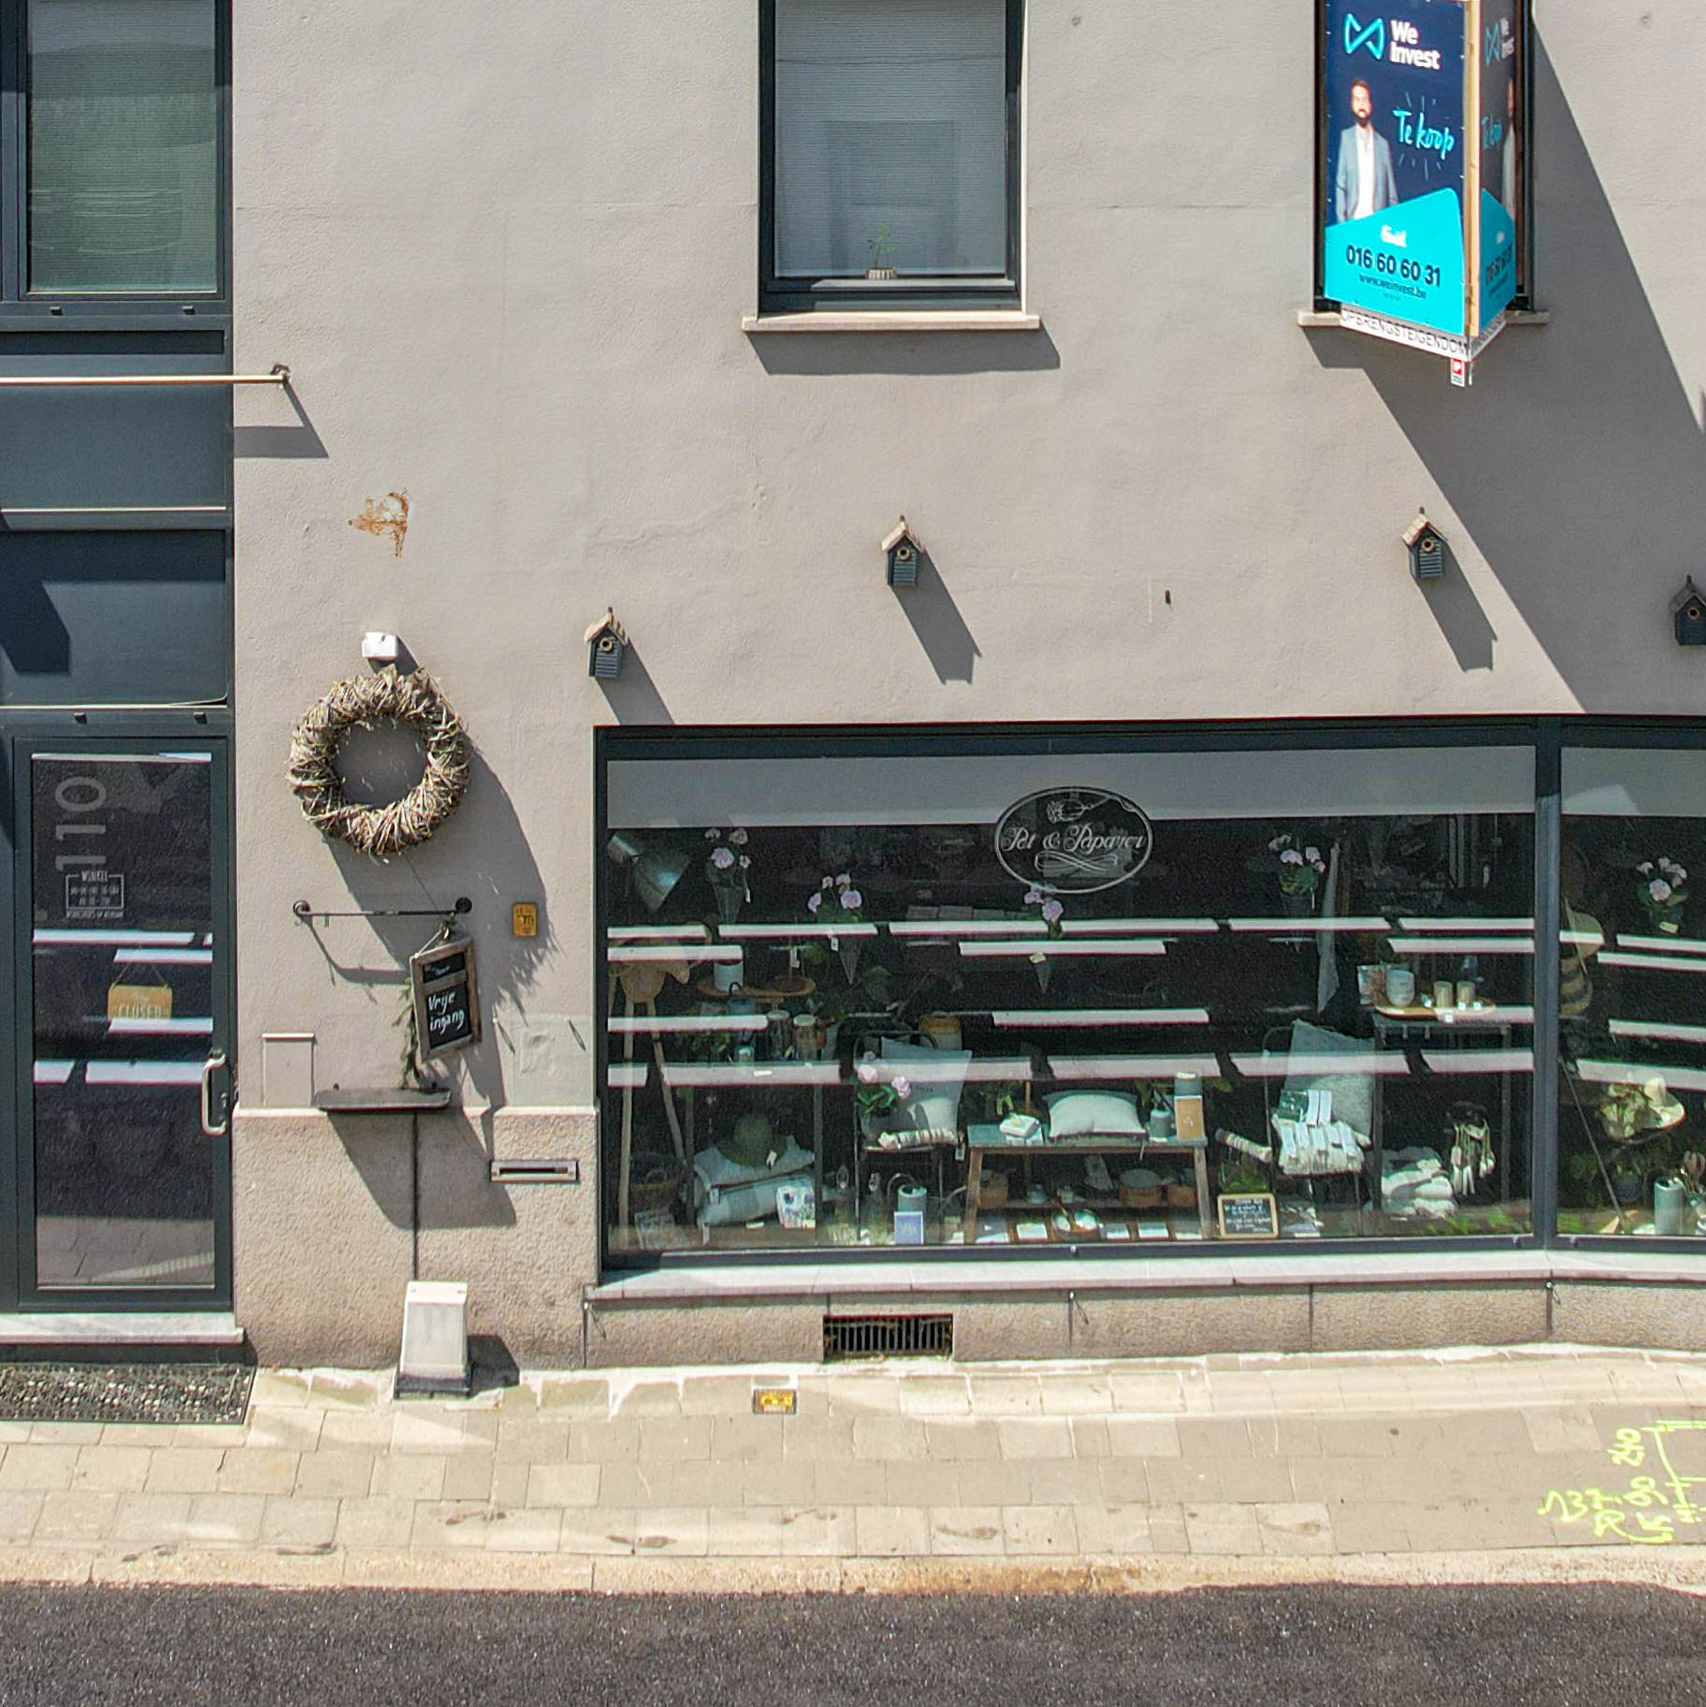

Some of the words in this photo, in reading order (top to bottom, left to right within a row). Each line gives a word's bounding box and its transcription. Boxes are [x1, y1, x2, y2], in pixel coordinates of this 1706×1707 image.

[1390, 20, 1418, 45] We
[1390, 42, 1440, 70] Invest
[1393, 109, 1413, 144] Te
[1416, 112, 1455, 160] koop
[1346, 245, 1372, 269] 016
[1377, 252, 1396, 274] 60
[1401, 258, 1421, 281] 60
[1424, 264, 1441, 287] 31
[55, 776, 107, 872] 110
[428, 992, 456, 1015] Vrije
[429, 1009, 465, 1035] ingang
